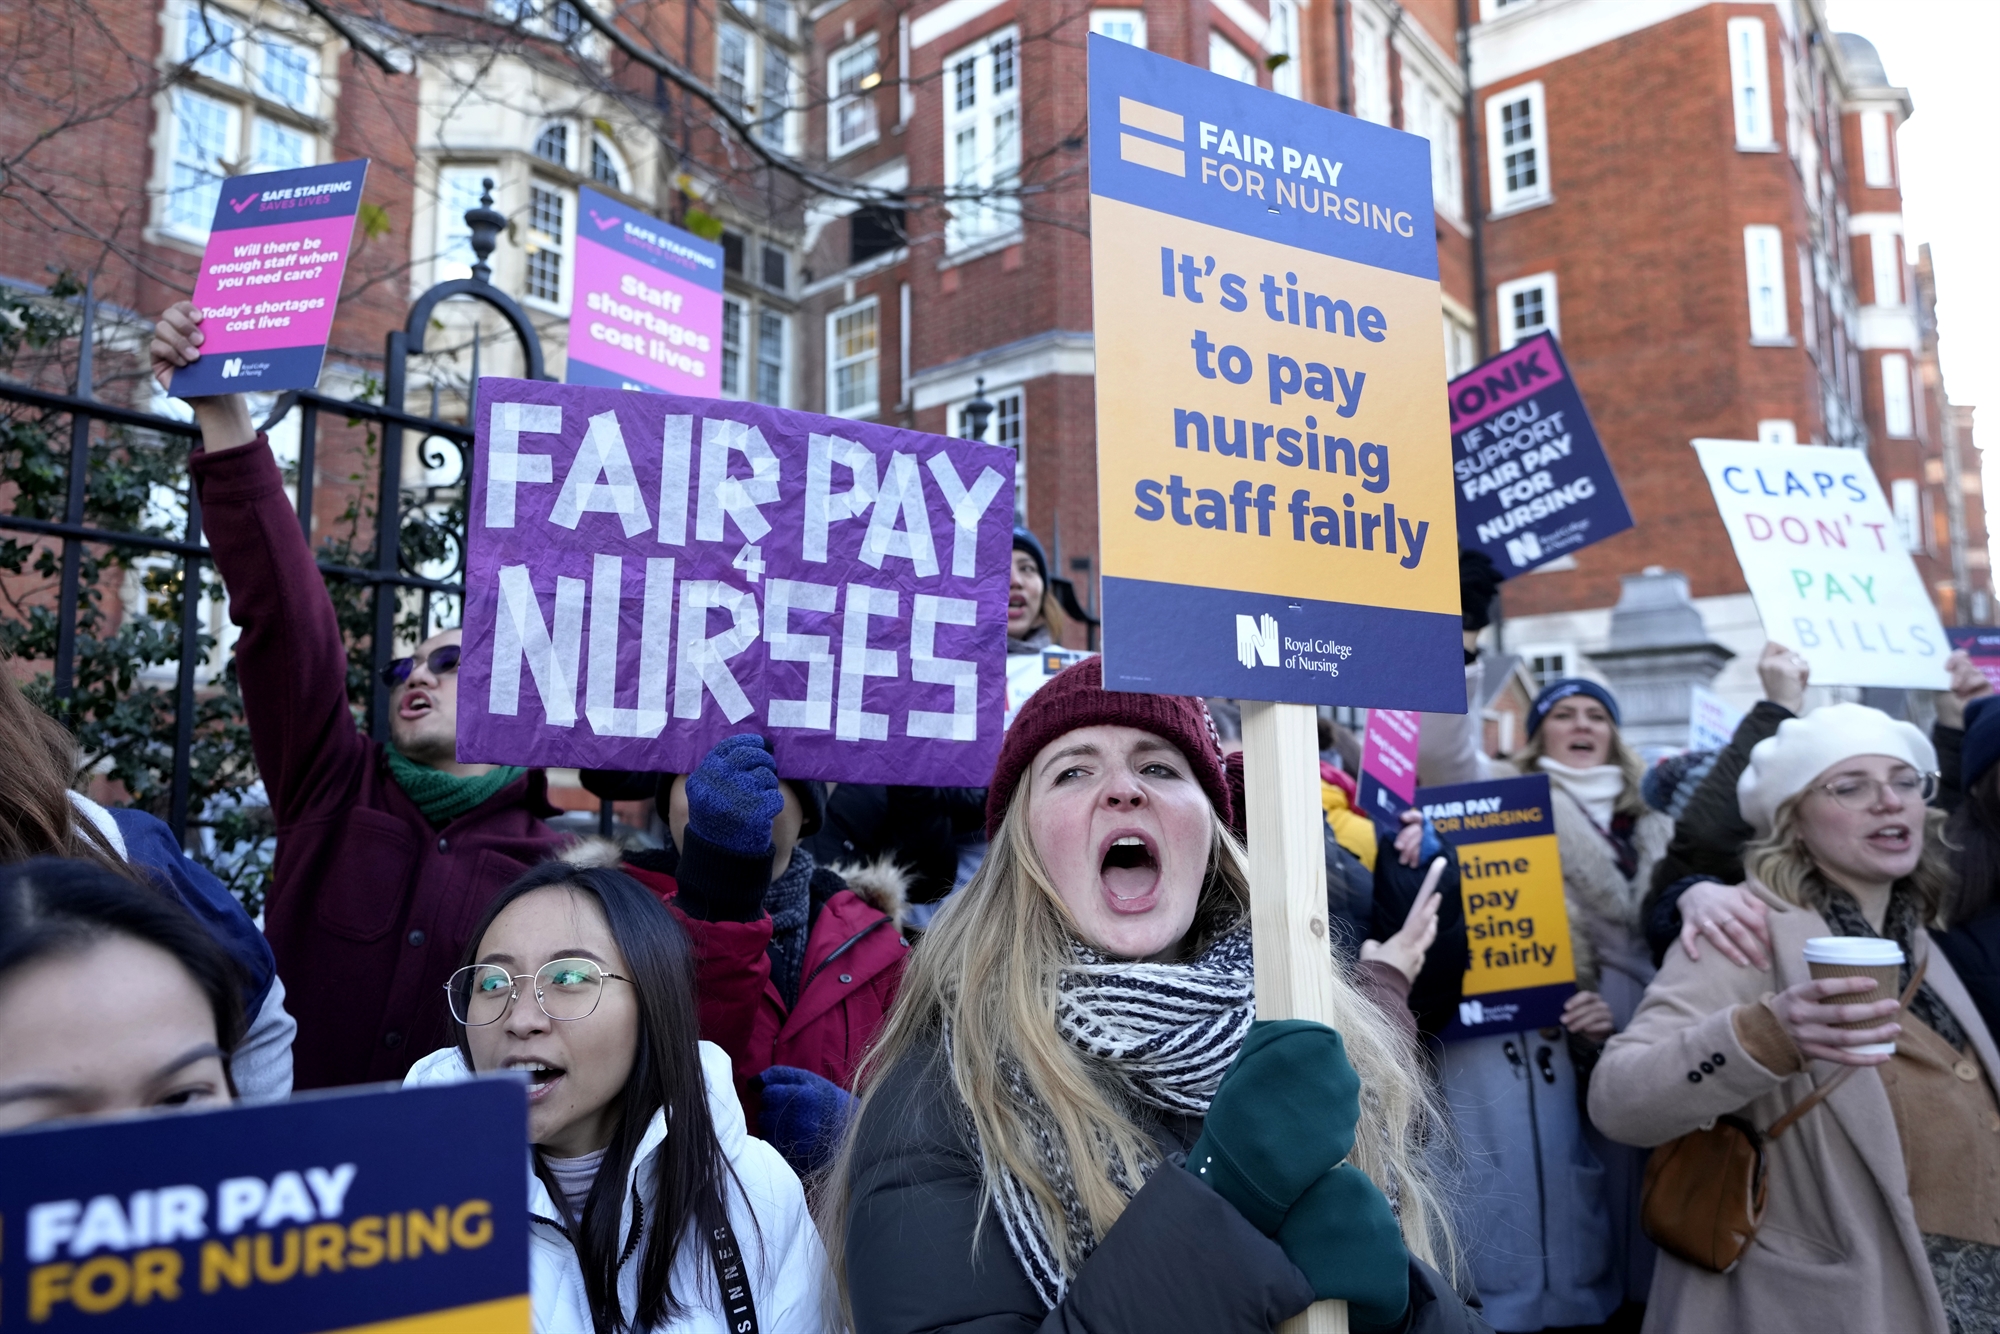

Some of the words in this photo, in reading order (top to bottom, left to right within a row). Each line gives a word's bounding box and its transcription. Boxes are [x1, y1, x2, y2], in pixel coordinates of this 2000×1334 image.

[1200, 121, 1275, 170] FAIR
[1282, 146, 1343, 187] PAY
[259, 198, 295, 212] SAVES
[298, 194, 330, 208] LIVES
[261, 189, 292, 202] SAFE
[293, 181, 352, 198] STAFFING
[1202, 157, 1265, 200] FOR
[1276, 178, 1414, 238] NURSING
[209, 259, 261, 275] enough
[263, 254, 297, 270] staff
[299, 250, 338, 265] when
[233, 243, 261, 258] Will
[262, 241, 300, 255] there
[303, 238, 321, 250] be
[623, 221, 657, 245] SAFE
[657, 236, 717, 270] STAFFING
[216, 276, 243, 292] you
[246, 271, 281, 285] need
[284, 266, 322, 282] care?
[620, 274, 683, 315] Staff
[1160, 246, 1248, 313] It’s
[1260, 271, 1388, 343] time
[225, 318, 255, 332] cost
[258, 315, 291, 329] lives
[254, 297, 325, 315] shortages
[586, 292, 711, 352] shortages
[590, 322, 646, 355] cost
[650, 339, 706, 378] lives
[1190, 328, 1252, 384] to
[1268, 353, 1366, 418] pay
[1453, 410, 1565, 481] SUPPORT
[1461, 426, 1485, 453] IF
[1484, 400, 1540, 439] YOU
[1174, 408, 1390, 494] nursing
[1462, 460, 1522, 502] FAIR
[1520, 432, 1573, 473] PAY
[486, 402, 781, 547] FAIR
[802, 432, 1006, 578] PAY
[1498, 470, 1555, 509] FOR
[1722, 466, 1867, 502] CLAPS
[1134, 474, 1276, 537] staff
[1288, 489, 1430, 570] fairly
[1476, 476, 1596, 544] NURSING
[1744, 512, 1886, 552] DON'T
[732, 542, 766, 582] 4
[1790, 568, 1876, 604] PAY
[488, 553, 978, 742] NURSES
[1284, 636, 1313, 656] Royal
[1315, 640, 1352, 660] College
[1791, 616, 1936, 657] BILLS
[1285, 655, 1296, 669] of
[1299, 656, 1339, 678] Nursing
[1422, 801, 1465, 820] FAIR
[1465, 796, 1503, 815] PAY
[1432, 817, 1461, 834] OR
[1464, 806, 1543, 830] NURSING
[1461, 856, 1529, 880] time
[1468, 888, 1518, 914] pay
[1466, 916, 1534, 939] sing
[1483, 941, 1556, 968] fairly
[26, 1184, 208, 1262] FAIR
[216, 1162, 357, 1234] PAY
[28, 1248, 182, 1323] FOR
[200, 1199, 493, 1294] NURSING
